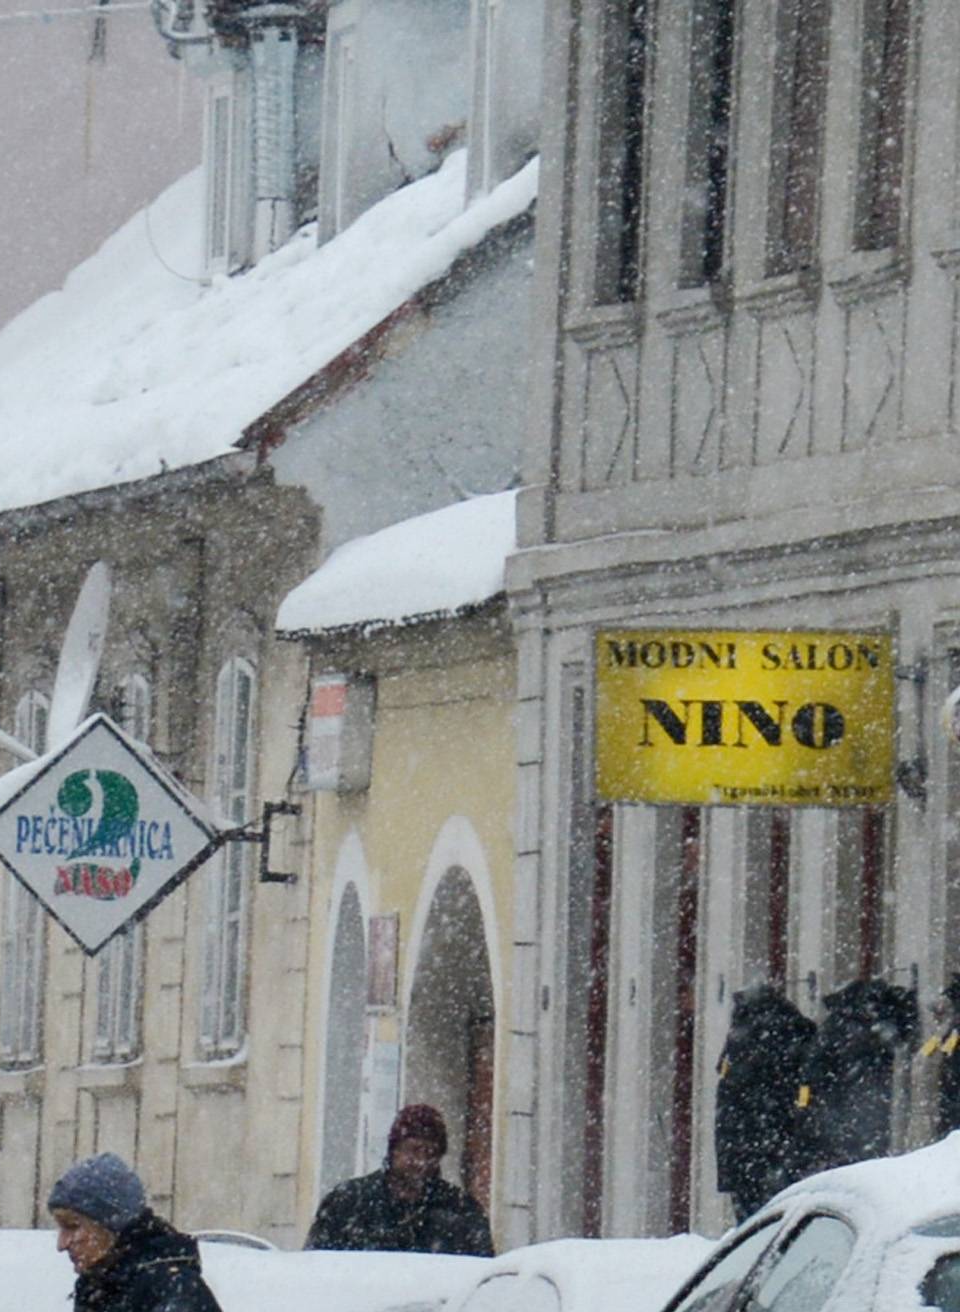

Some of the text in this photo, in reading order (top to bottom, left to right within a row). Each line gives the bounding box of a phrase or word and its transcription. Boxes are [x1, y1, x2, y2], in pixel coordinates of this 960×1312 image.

[606, 640, 881, 671] MODNI SALON
[638, 699, 846, 749] NINO
